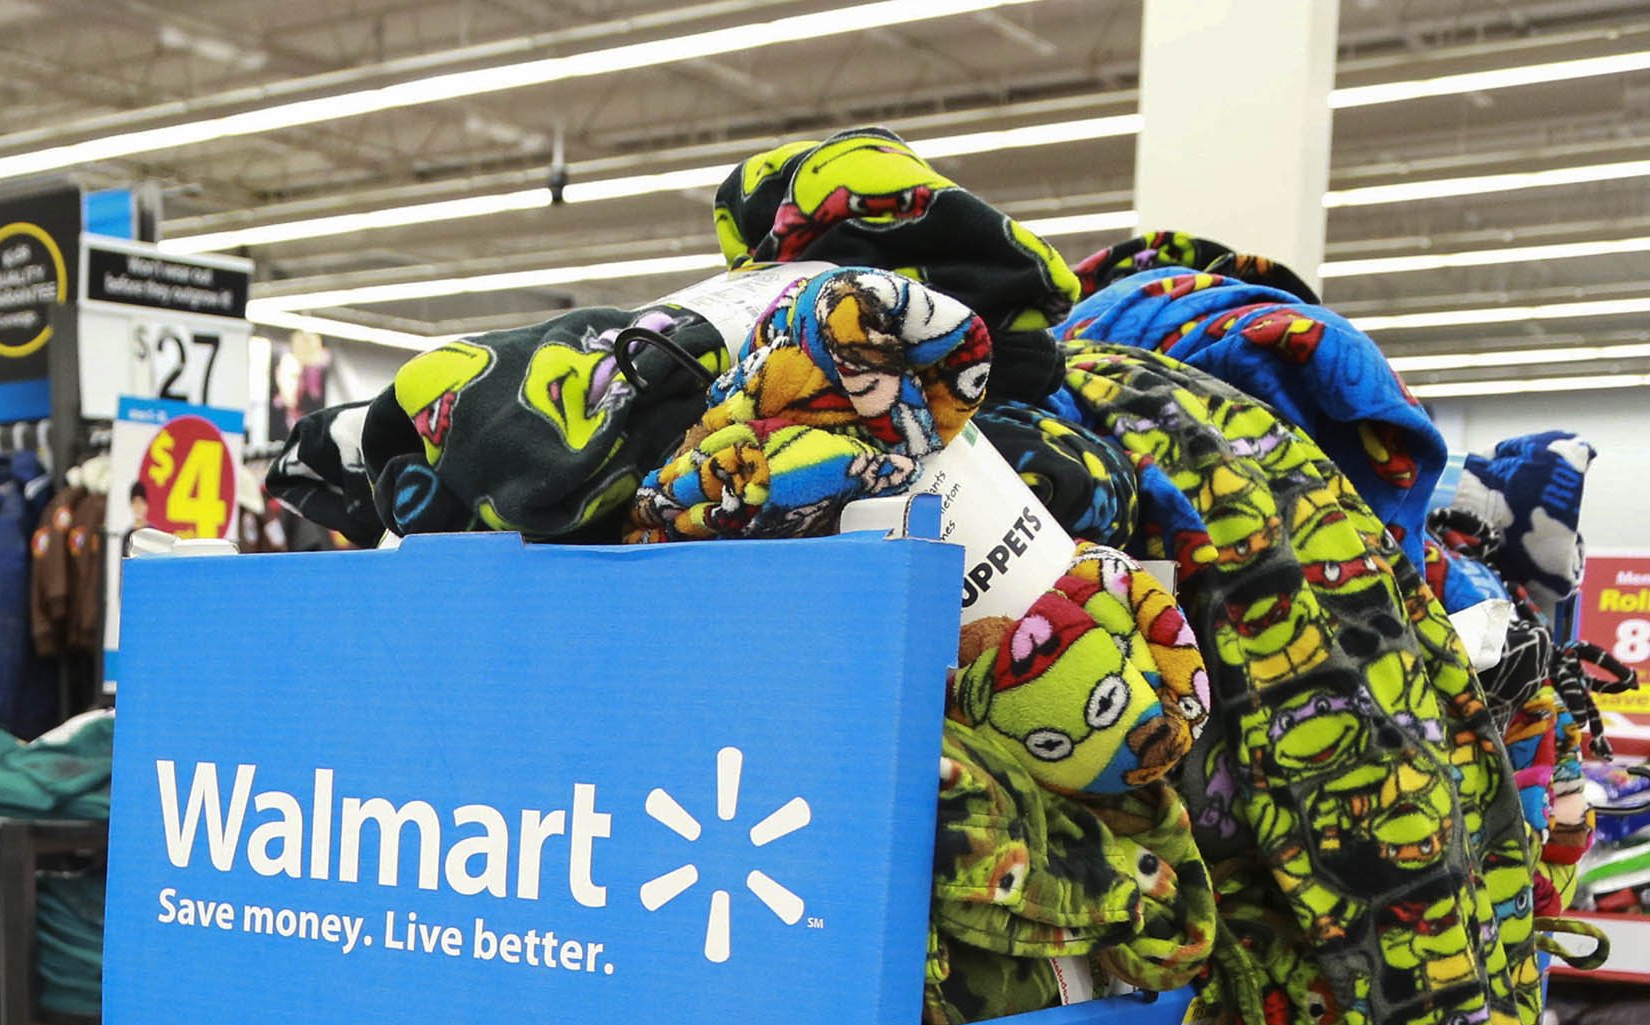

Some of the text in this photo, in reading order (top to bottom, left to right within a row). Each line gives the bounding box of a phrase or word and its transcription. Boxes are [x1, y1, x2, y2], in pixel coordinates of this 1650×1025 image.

[147, 429, 227, 539] $4
[156, 759, 613, 909] Walmart
[158, 887, 614, 976] Save money. Live better.
